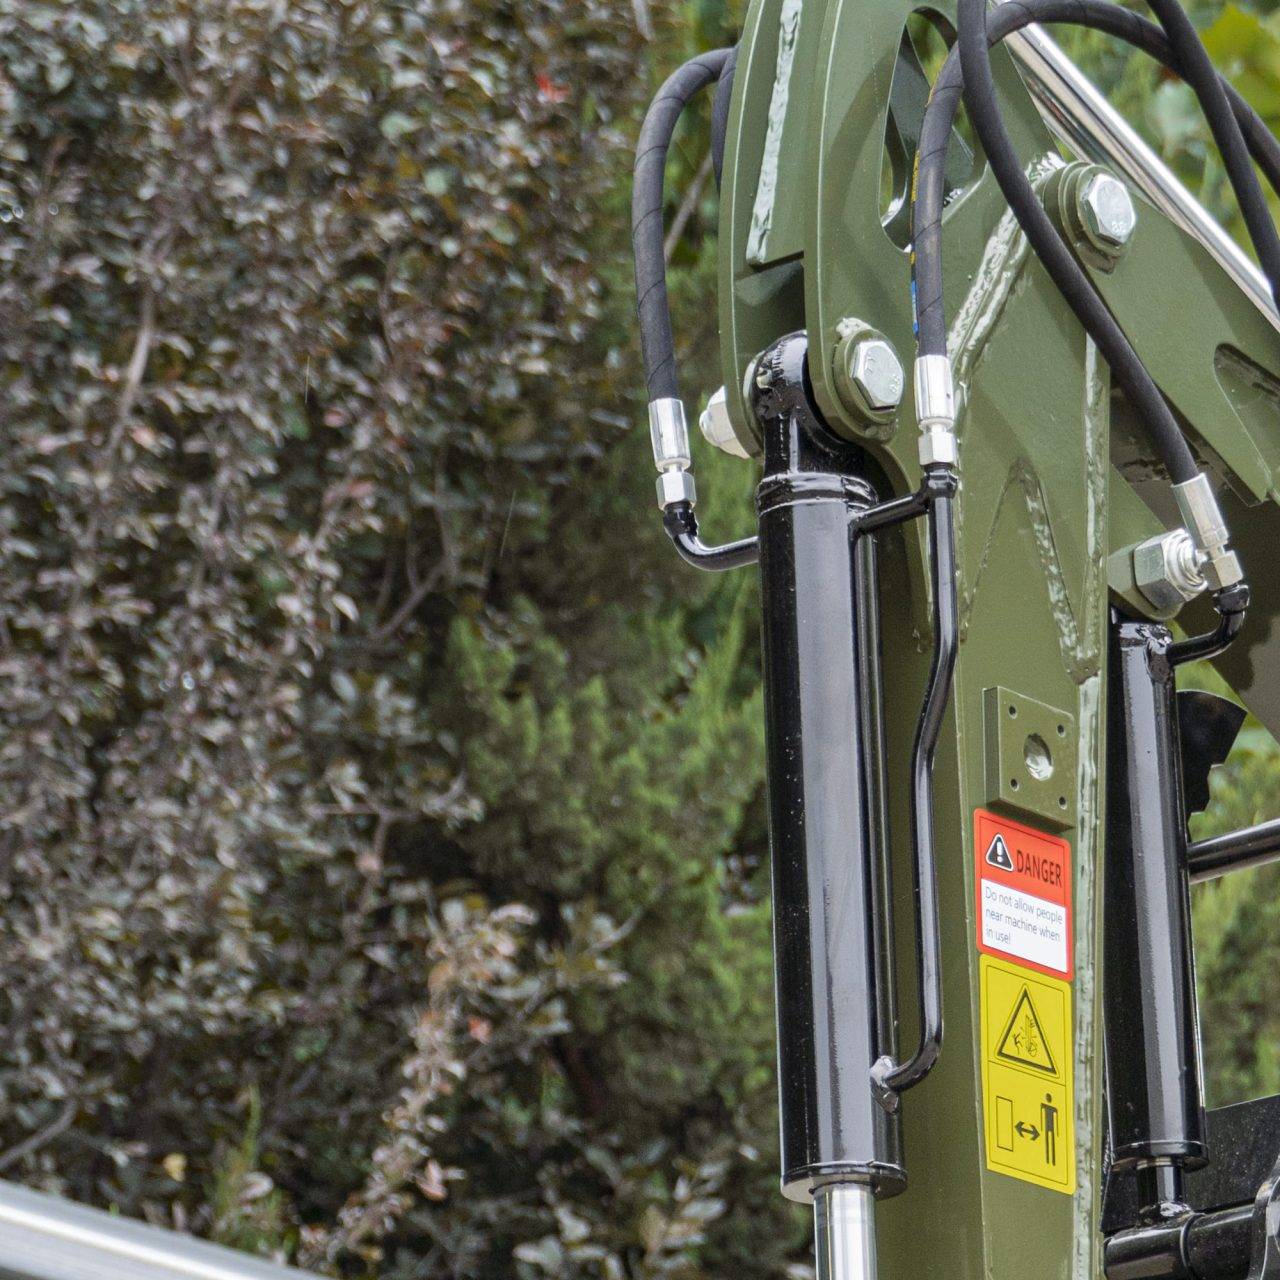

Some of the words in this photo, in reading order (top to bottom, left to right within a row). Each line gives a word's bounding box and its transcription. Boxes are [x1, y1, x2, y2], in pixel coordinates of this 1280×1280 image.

[1016, 849, 1063, 888] DANGER
[985, 886, 997, 901] Do
[1000, 894, 1013, 907] not
[1014, 897, 1035, 914] allow
[1036, 907, 1063, 925] people
[985, 908, 1003, 922] near
[1005, 914, 1038, 935] machine
[1039, 924, 1060, 942] when
[986, 927, 994, 939] in
[995, 930, 1011, 944] use!
